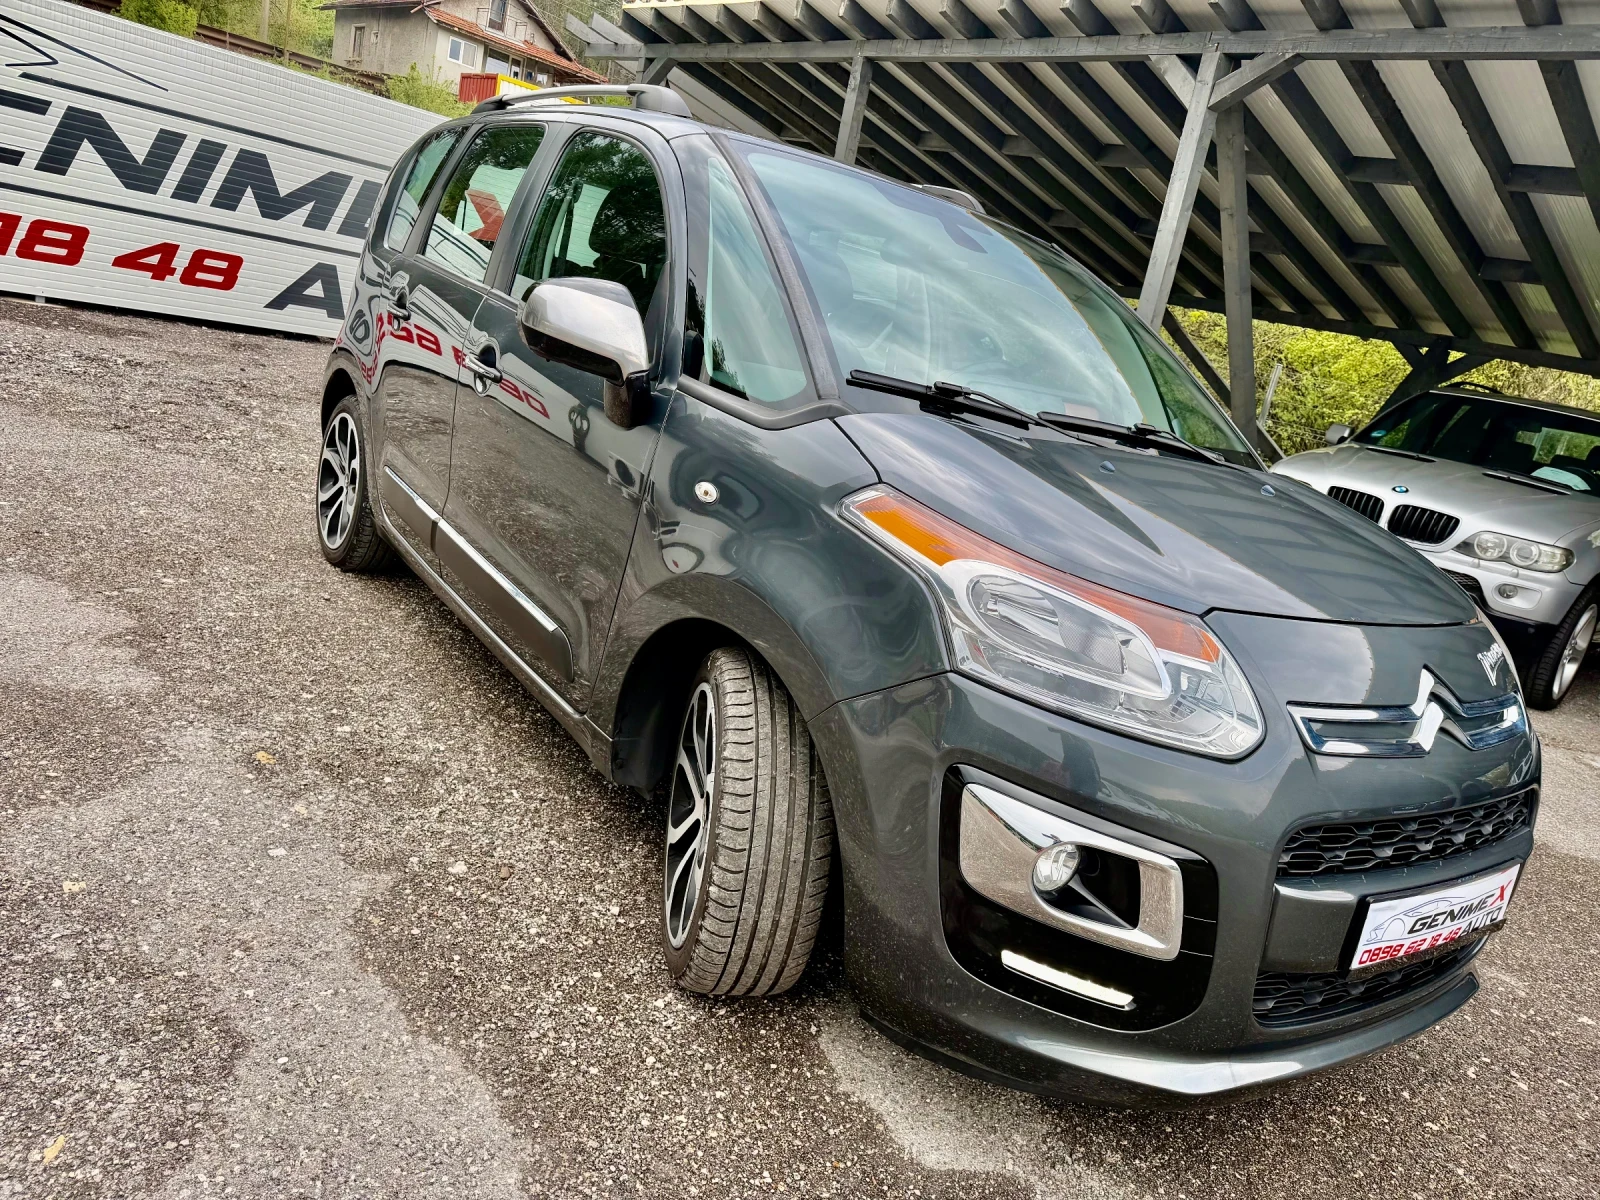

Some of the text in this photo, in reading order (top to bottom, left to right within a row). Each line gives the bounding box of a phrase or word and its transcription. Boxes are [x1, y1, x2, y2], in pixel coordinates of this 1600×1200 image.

[111, 241, 245, 292] 48
[1407, 879, 1513, 935] GENIMEX
[1459, 905, 1504, 937] AUTO
[1358, 926, 1463, 965] 0898 62 18 48
